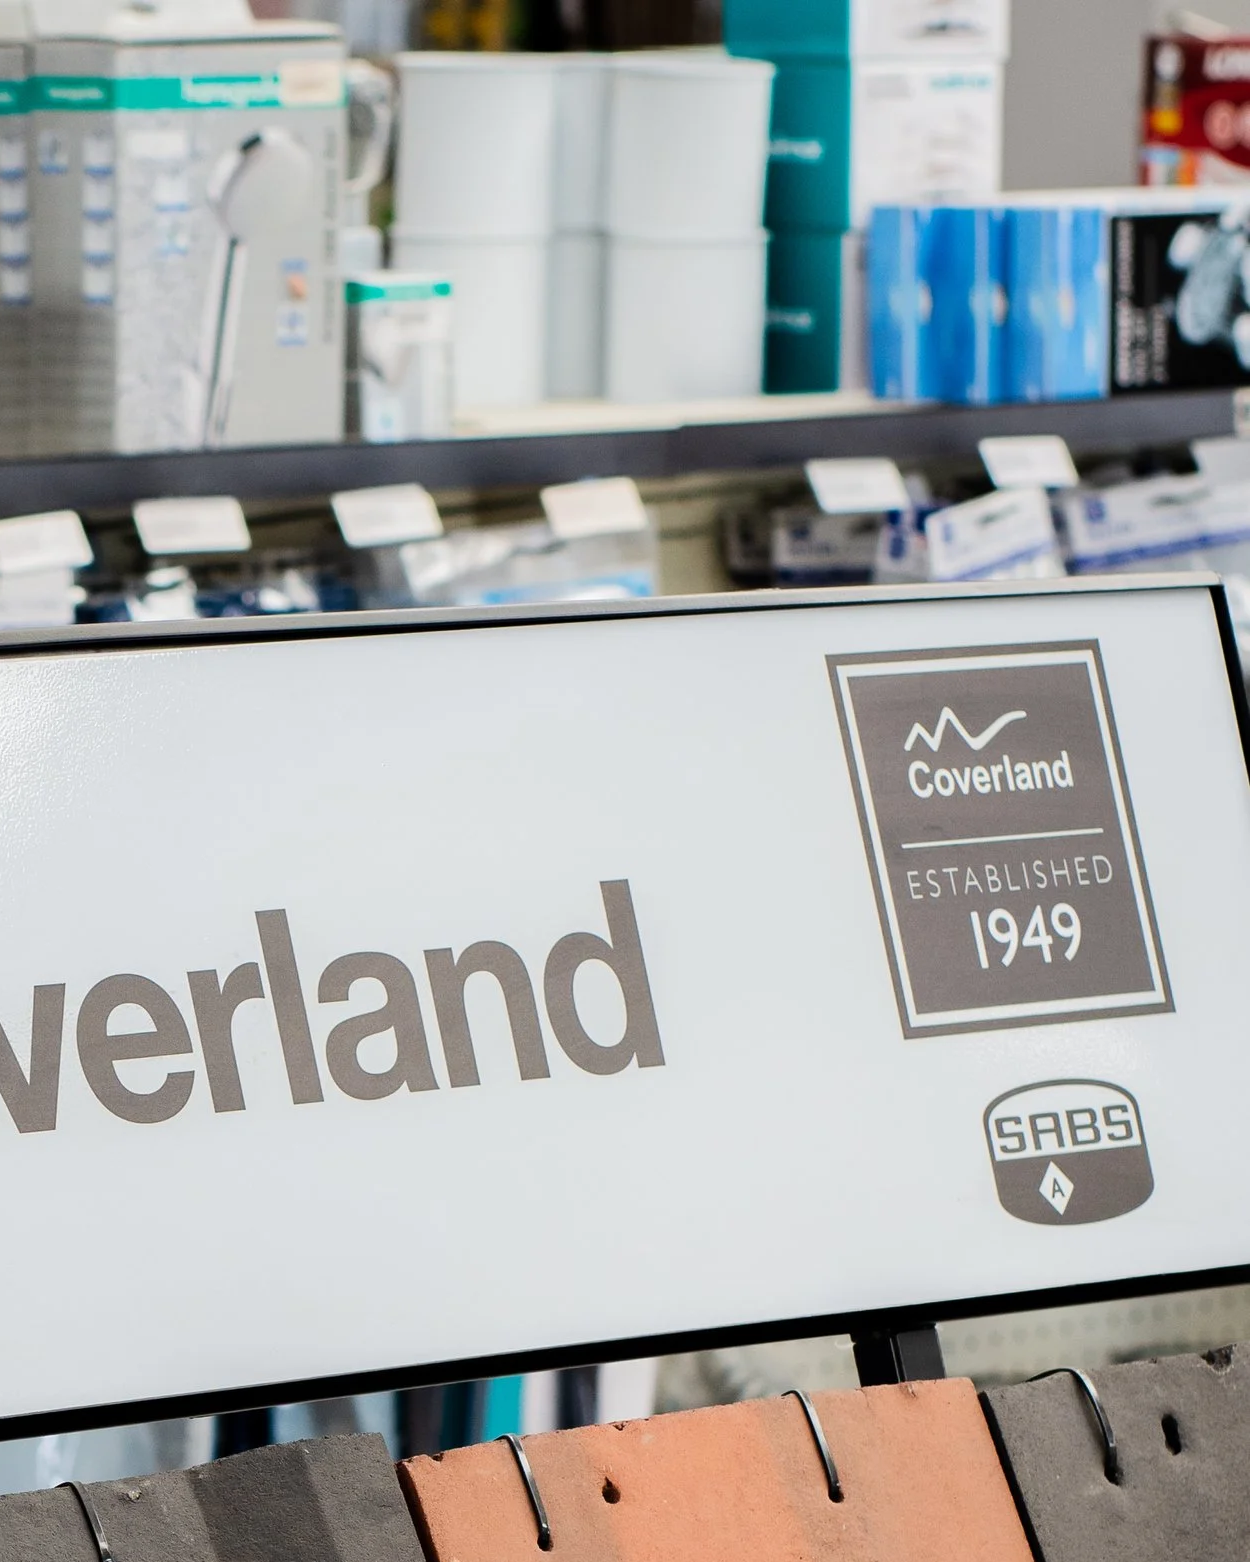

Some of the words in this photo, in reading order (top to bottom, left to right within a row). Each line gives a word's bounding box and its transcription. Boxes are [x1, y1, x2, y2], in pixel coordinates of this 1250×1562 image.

[908, 750, 1074, 799] Coverland
[906, 854, 1113, 900] ESTABLISHED
[970, 902, 1082, 969] 1949
[994, 1103, 1135, 1154] SABS
[1052, 1177, 1065, 1199] A
